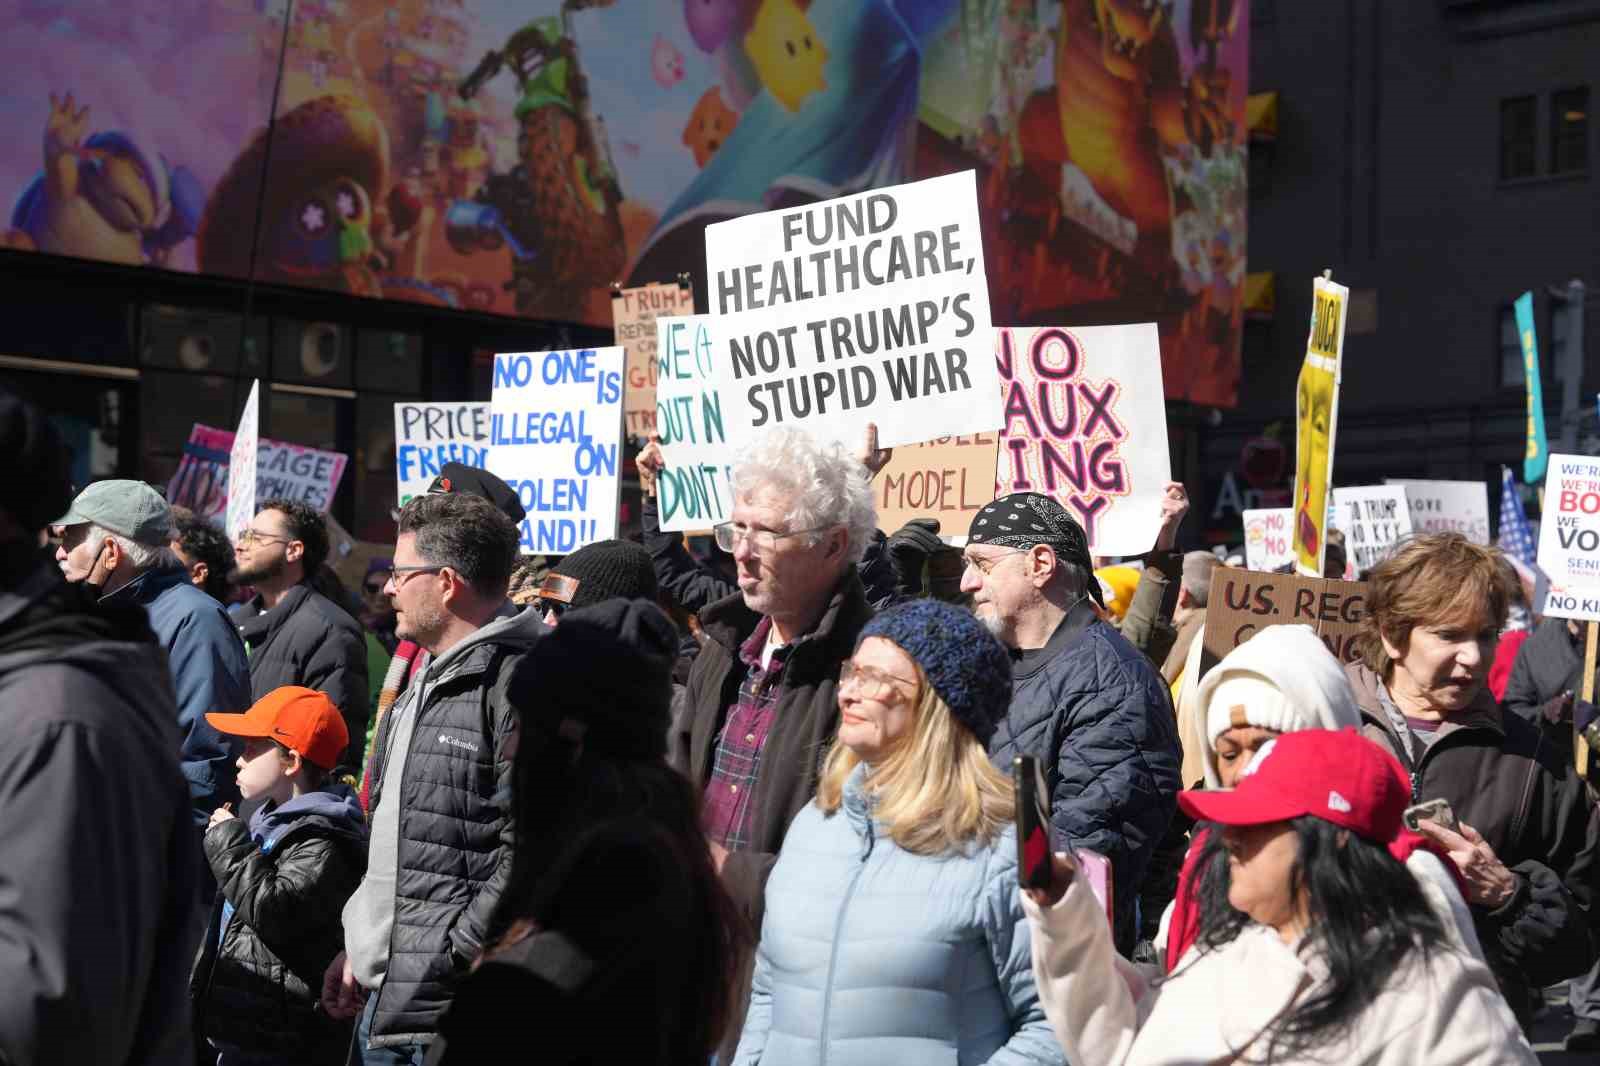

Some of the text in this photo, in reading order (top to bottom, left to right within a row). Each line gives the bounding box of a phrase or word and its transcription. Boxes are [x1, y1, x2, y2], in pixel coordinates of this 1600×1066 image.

[782, 193, 898, 252] FUND
[717, 223, 975, 315] HEALTHCARE,
[623, 290, 690, 313] TRUMP
[729, 292, 975, 379] NOT TRUMP'S
[494, 350, 621, 404] NO ONE IS
[747, 347, 972, 427] STUPID WAR
[1000, 380, 1123, 439] AUX
[491, 410, 593, 446] ILLEGAL
[575, 444, 616, 477] ON
[995, 439, 1126, 493] ING
[1561, 463, 1600, 477] WE'R
[883, 467, 982, 512] MODEL
[1561, 479, 1600, 492] WE'R
[1557, 515, 1580, 529] WE
[1557, 527, 1600, 552] VO
[1550, 595, 1578, 611] NO
[446, 735, 479, 752] Columbia
